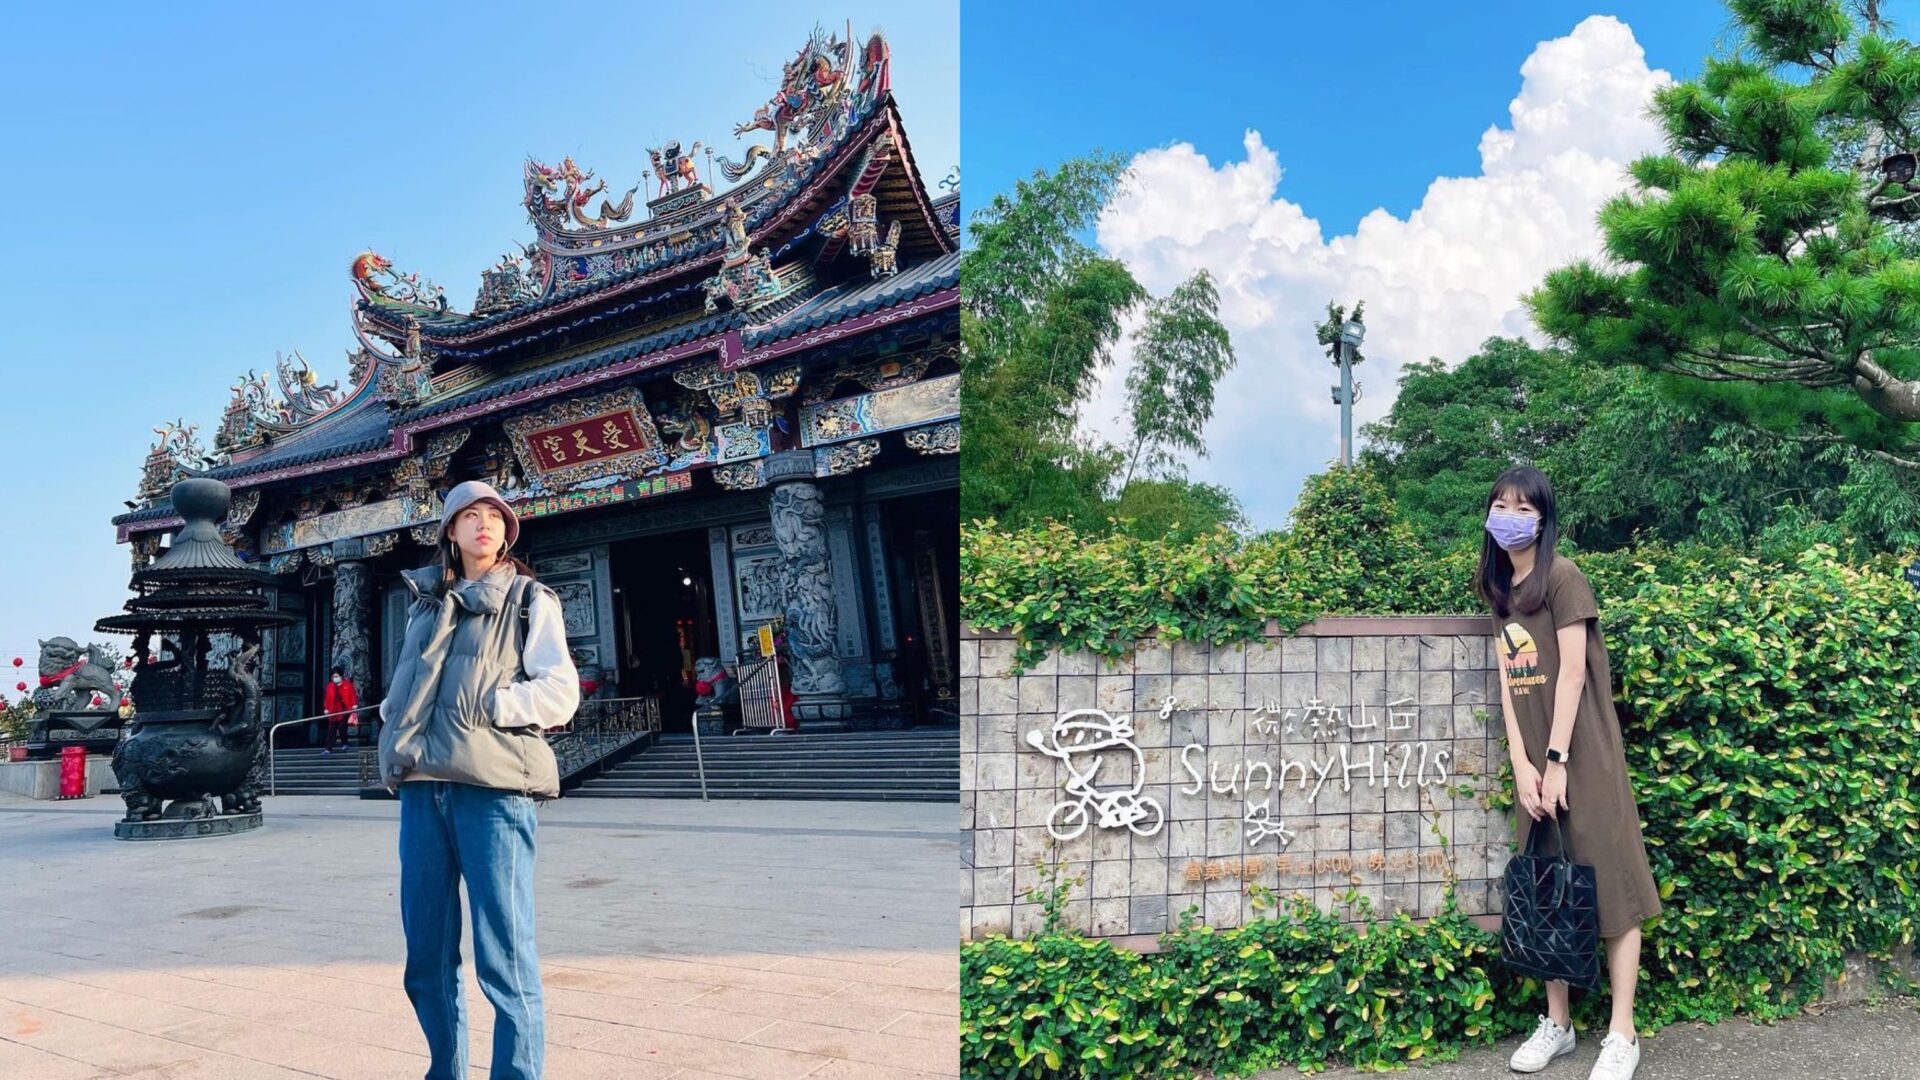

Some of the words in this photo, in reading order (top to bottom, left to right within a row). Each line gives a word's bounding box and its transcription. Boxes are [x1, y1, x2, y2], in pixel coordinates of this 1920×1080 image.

[543, 420, 630, 463] 受天宮
[1251, 695, 1418, 739] 微熱山丘
[1180, 741, 1451, 804] SunnyHills
